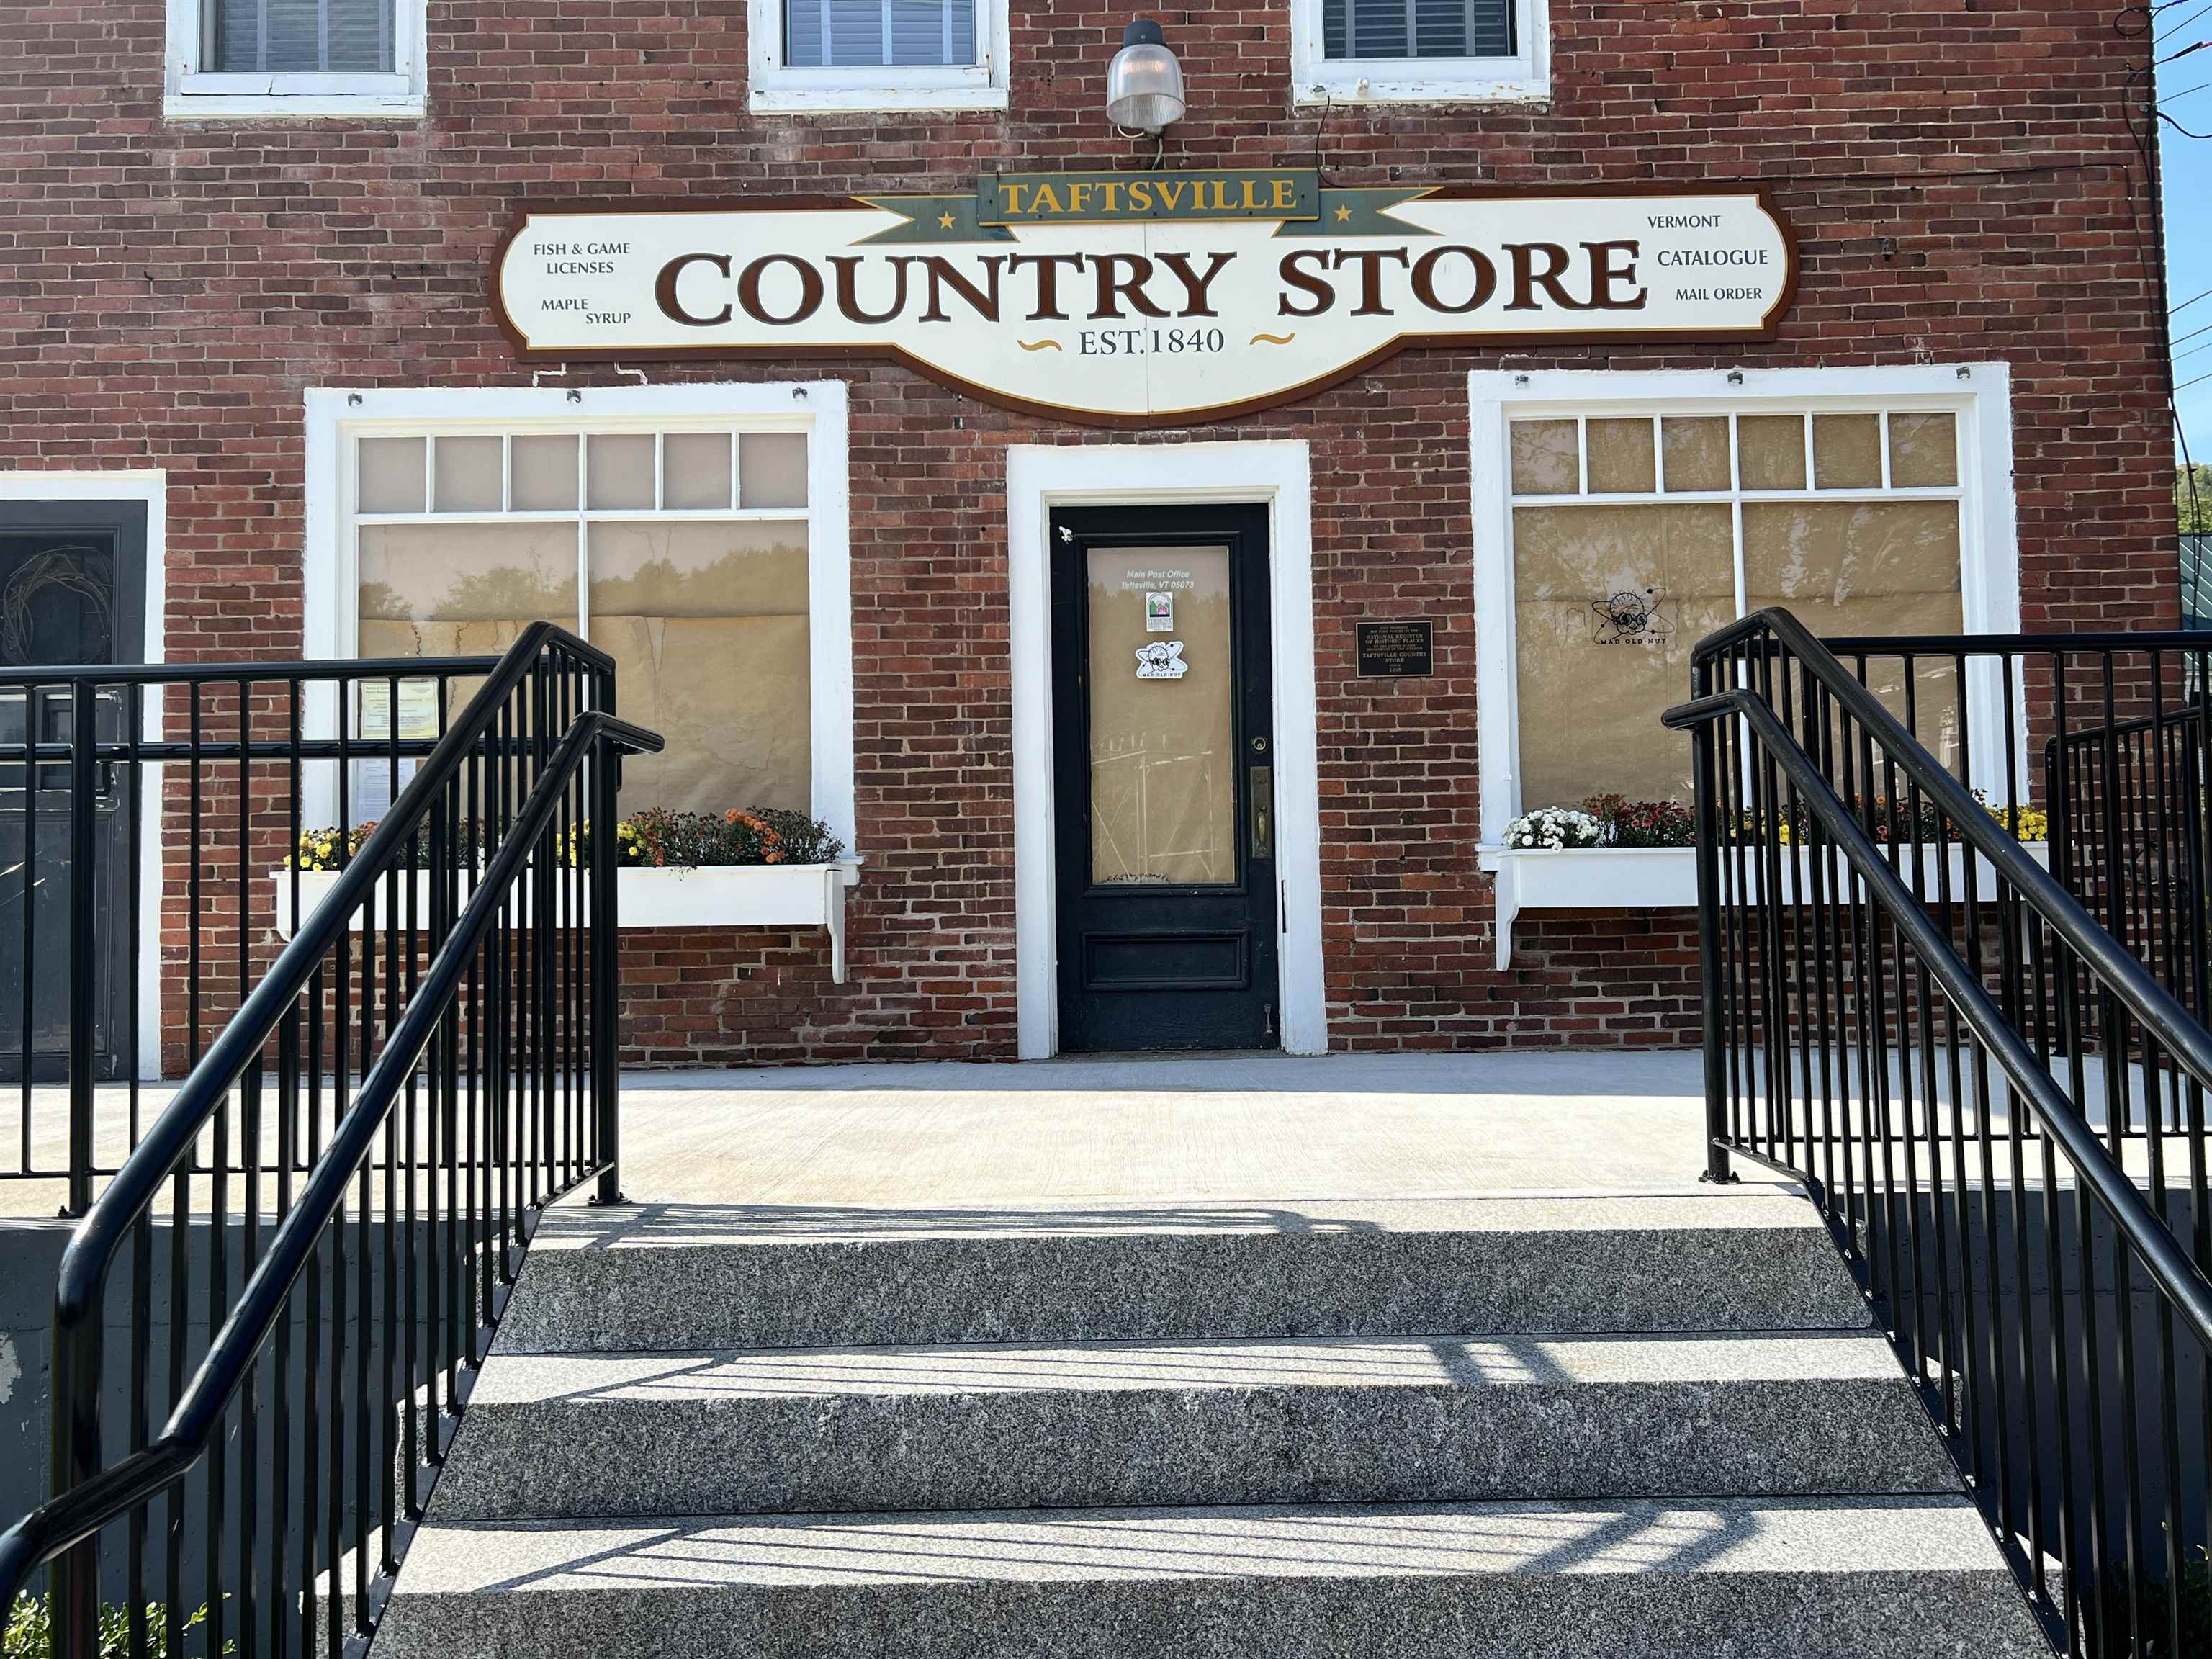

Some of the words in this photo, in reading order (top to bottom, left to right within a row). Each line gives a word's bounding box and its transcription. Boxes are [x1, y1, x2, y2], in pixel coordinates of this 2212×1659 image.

[999, 179, 1296, 213] TAFTSVILLE
[1647, 215, 1721, 228] VERMONT
[534, 244, 566, 255] FISH
[572, 244, 582, 254] &
[588, 243, 629, 254] GAME
[1658, 250, 1768, 266] CATALOGUE
[547, 262, 613, 274] LICENSES
[655, 251, 1237, 326] COUNTRY
[1278, 240, 1647, 316] STORE
[1676, 289, 1709, 300] MAIL
[1714, 288, 1762, 300] ORDER
[542, 299, 588, 310] MAPLE
[586, 313, 631, 324] SYRUP
